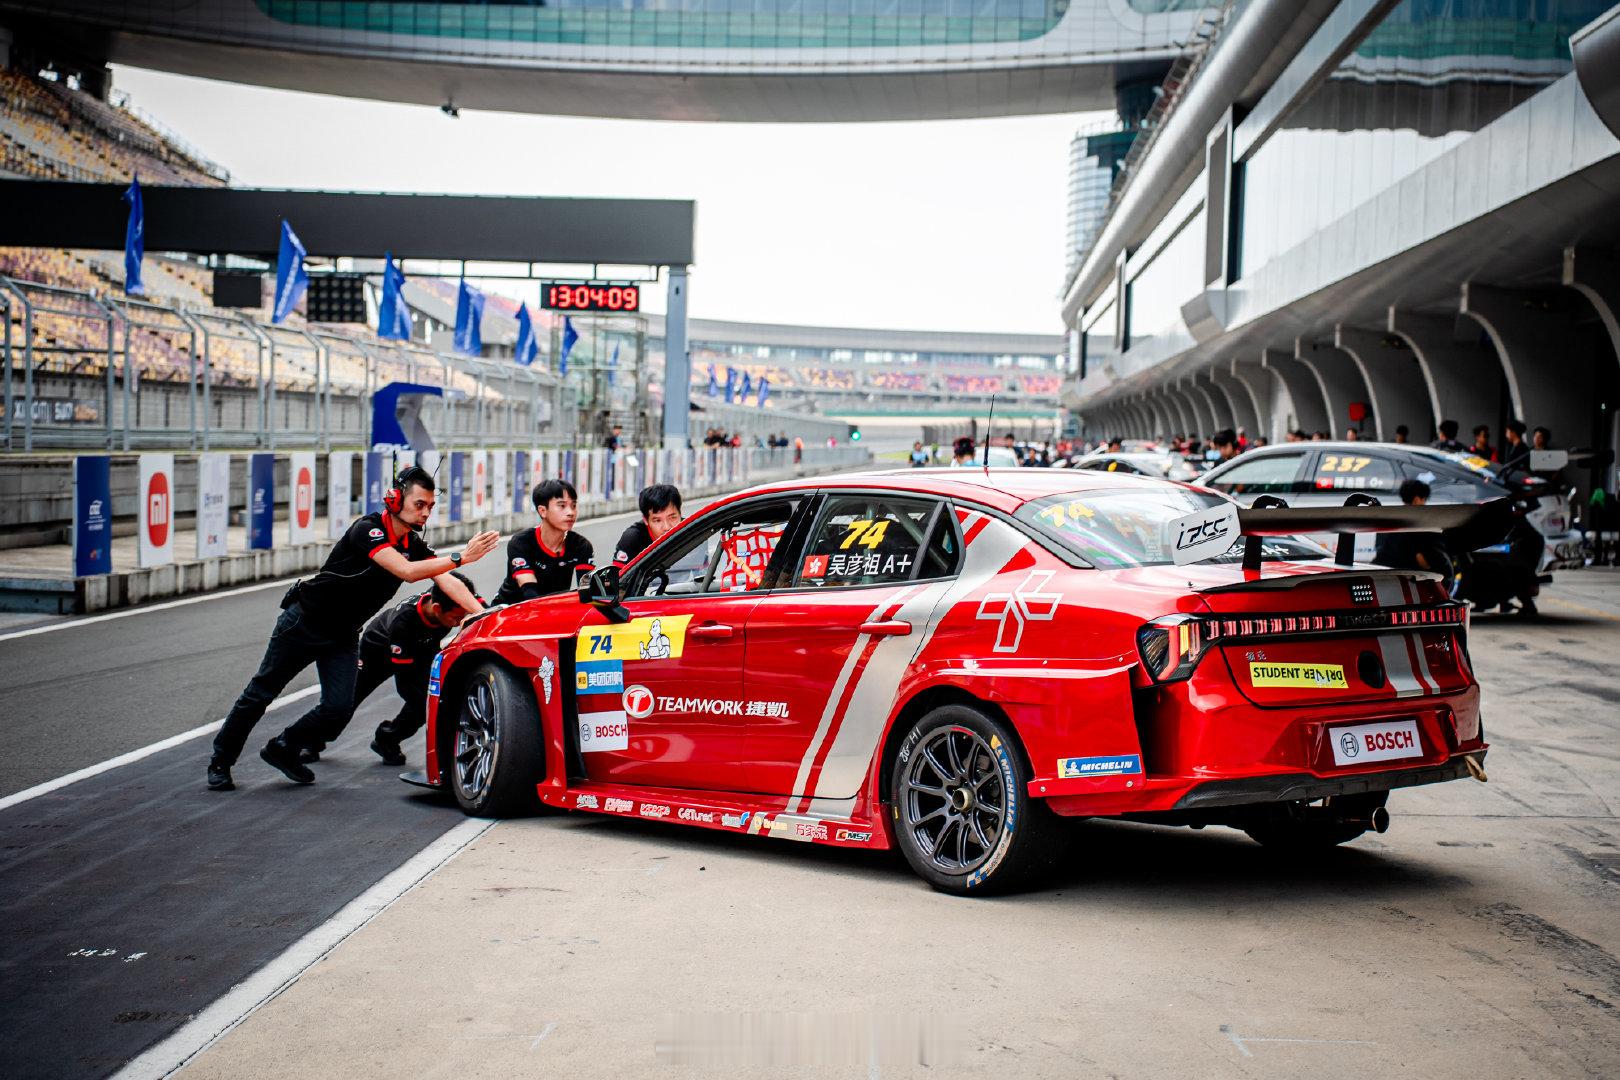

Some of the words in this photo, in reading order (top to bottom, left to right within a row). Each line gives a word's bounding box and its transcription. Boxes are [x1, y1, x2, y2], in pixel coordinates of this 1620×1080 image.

[550, 285, 638, 310] 13:04:09
[1321, 456, 1371, 472] 237
[1040, 503, 1095, 528] 74
[840, 520, 890, 549] 74
[828, 553, 881, 575] 吴彦祖
[882, 554, 912, 574] A+
[590, 635, 613, 654] 74
[588, 671, 623, 687] 美团团购
[1253, 667, 1300, 679] STUDENT
[656, 696, 744, 716] TEAMWORK
[595, 723, 628, 738] BOSCH
[1364, 730, 1415, 751] BOSCH
[1081, 761, 1133, 771] MICHELIN
[1001, 758, 1016, 825] MICHELIN
